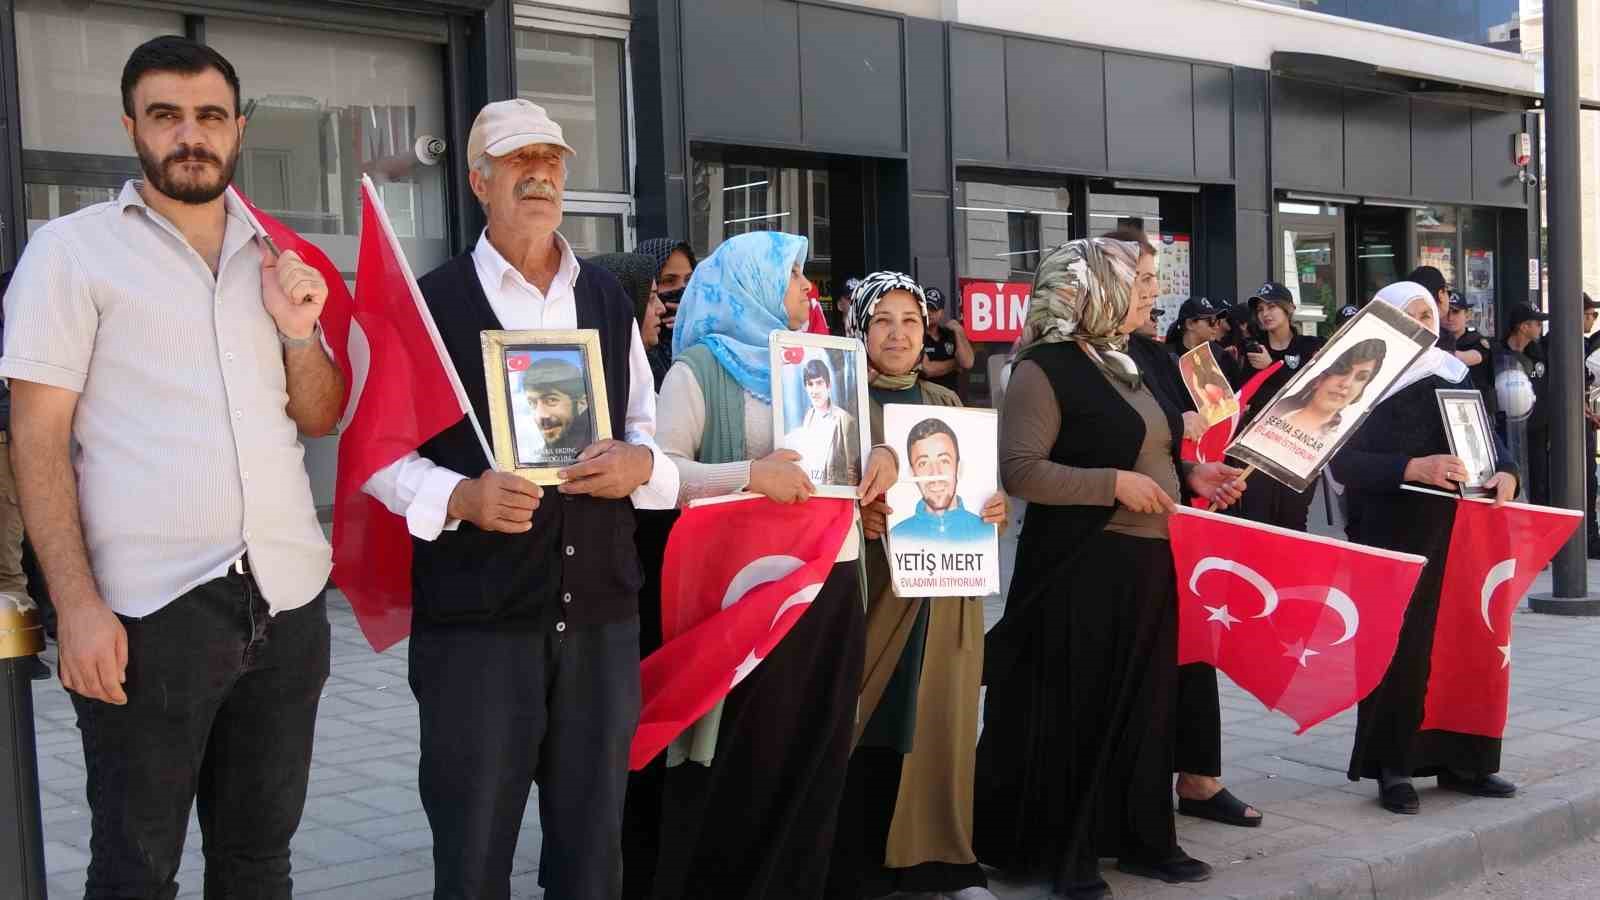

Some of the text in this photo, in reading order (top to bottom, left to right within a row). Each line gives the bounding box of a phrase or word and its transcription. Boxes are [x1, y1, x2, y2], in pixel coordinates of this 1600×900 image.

[895, 549, 984, 576] YETİŞ MERT
[900, 577, 937, 588] EVLADIMI
